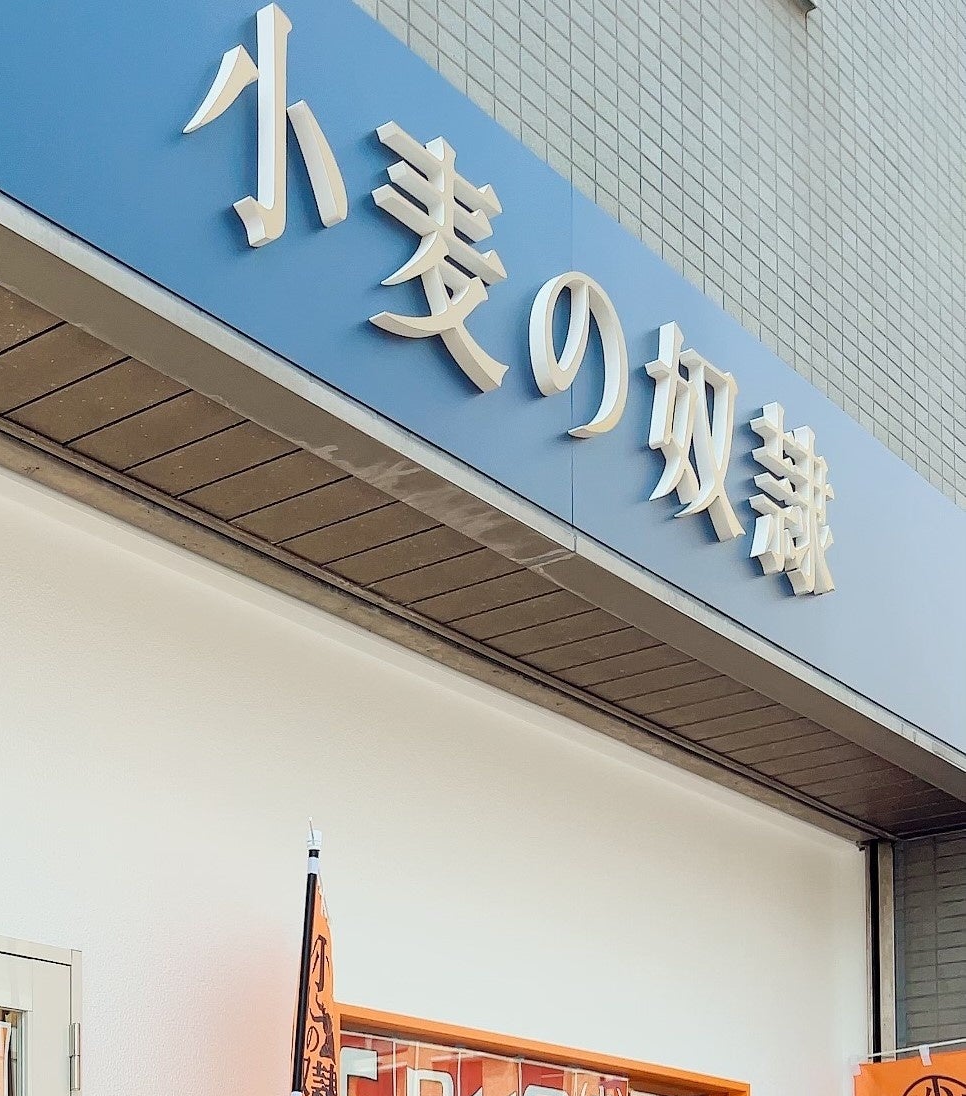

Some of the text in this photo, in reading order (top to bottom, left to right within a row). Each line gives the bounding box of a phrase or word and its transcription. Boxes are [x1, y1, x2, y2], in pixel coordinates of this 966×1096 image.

[182, 3, 835, 596] 小麦の奴隷
